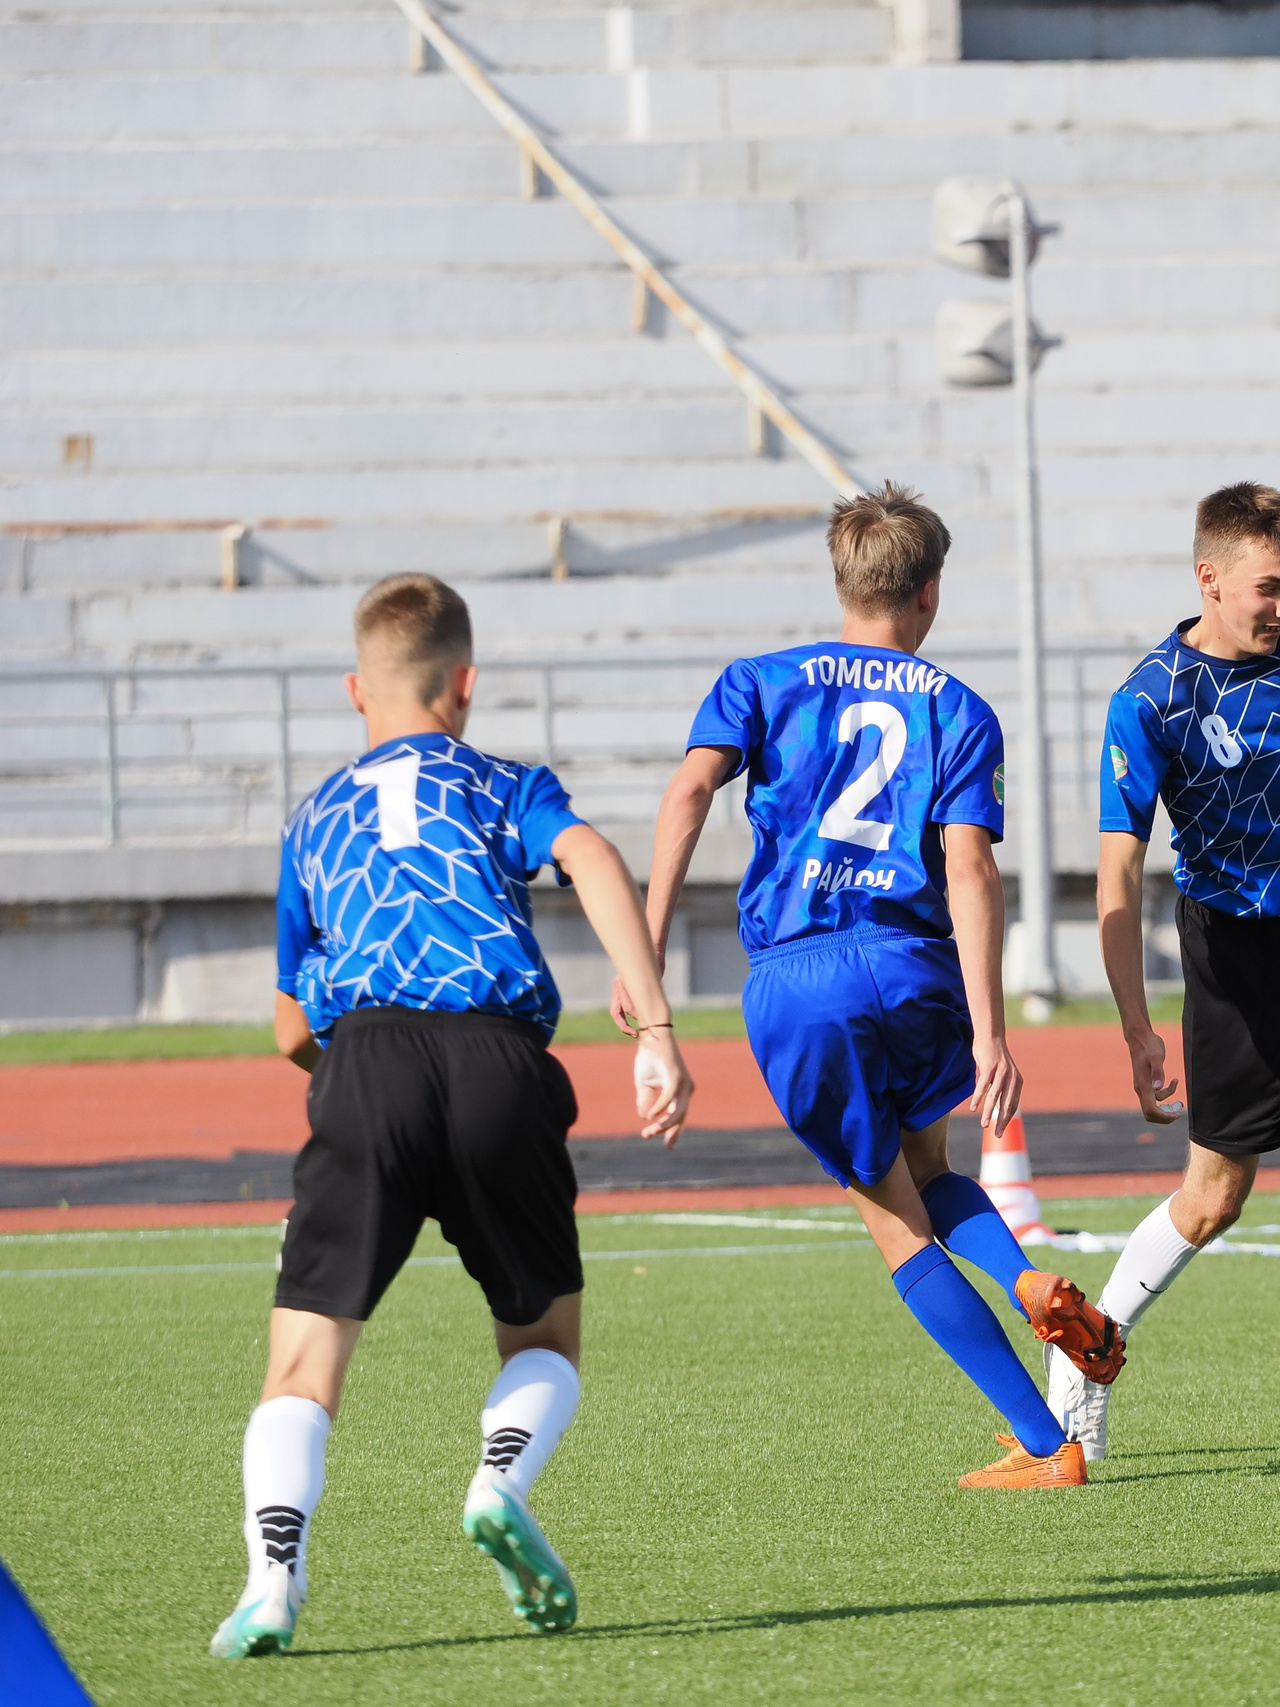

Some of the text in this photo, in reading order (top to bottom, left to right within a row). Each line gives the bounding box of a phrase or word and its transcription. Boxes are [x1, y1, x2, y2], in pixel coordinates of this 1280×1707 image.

[799, 655, 948, 697] ТОМСКИЙ
[818, 701, 908, 851] 2
[1201, 714, 1243, 768] 8
[353, 753, 422, 852] 1
